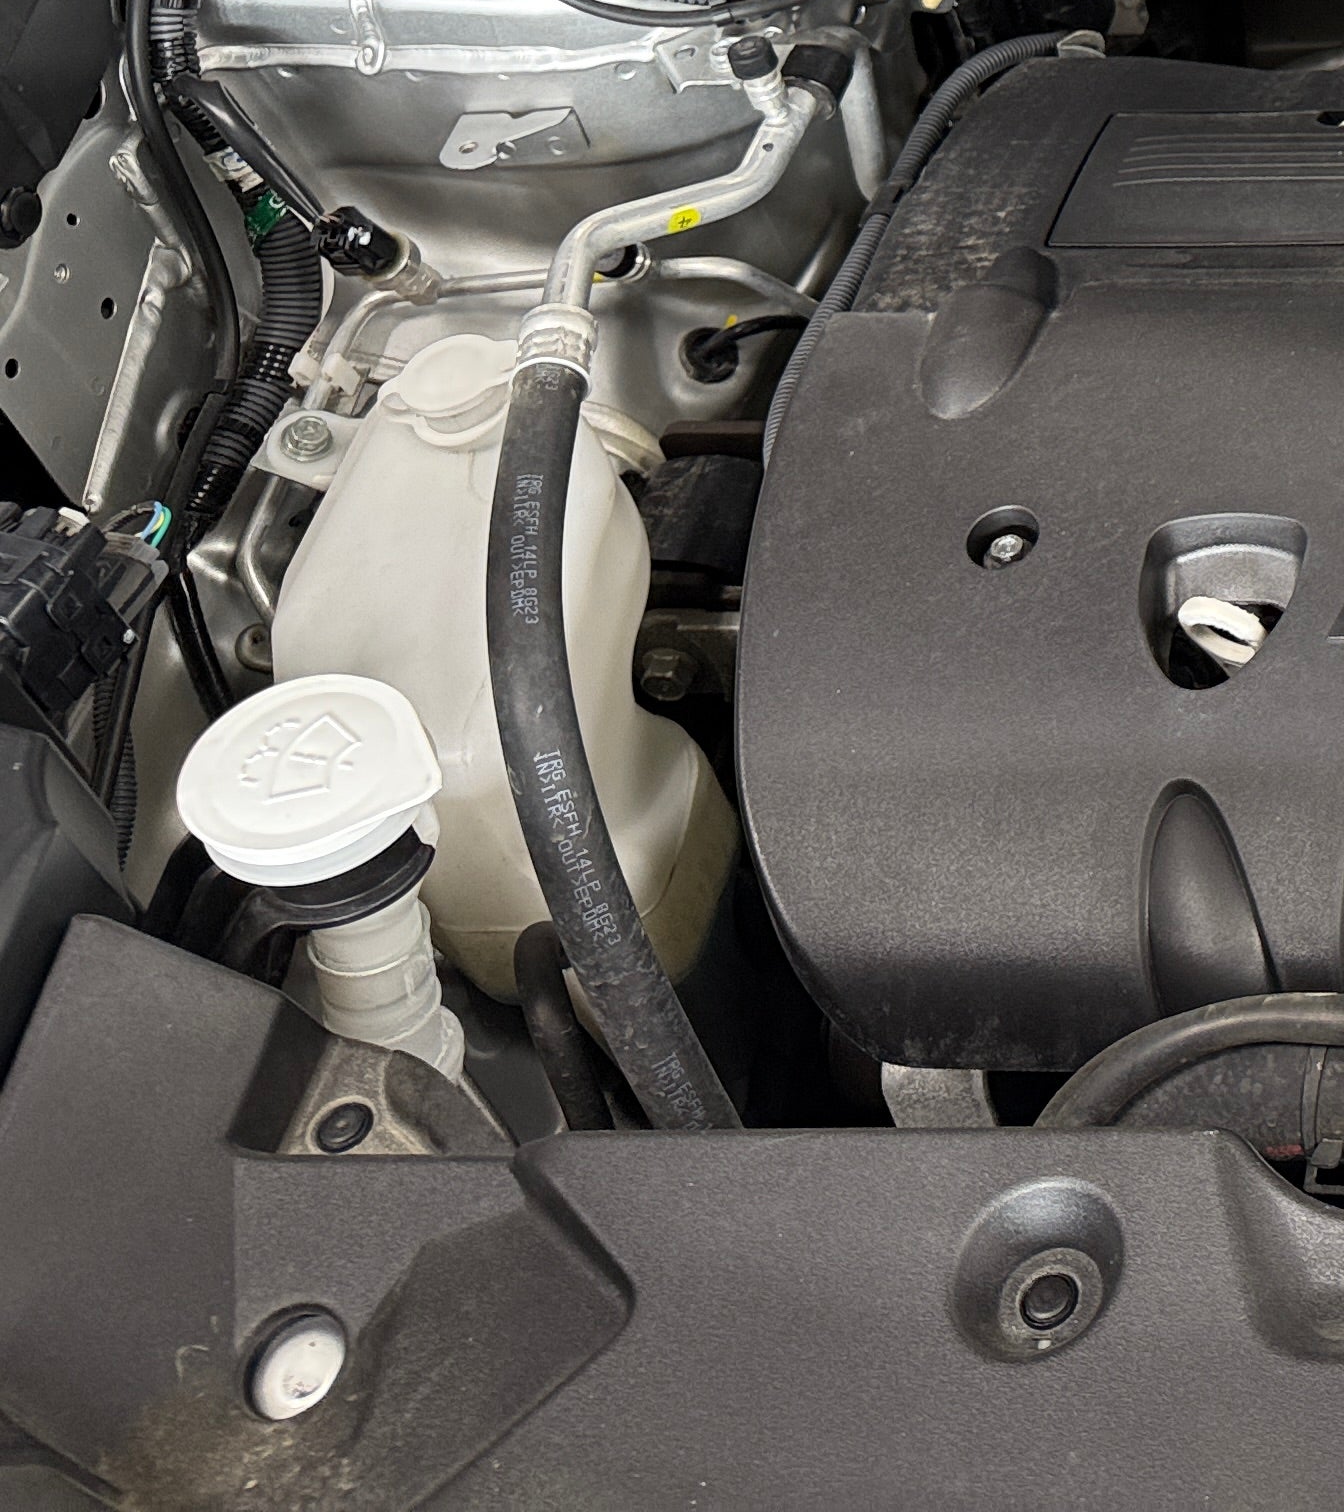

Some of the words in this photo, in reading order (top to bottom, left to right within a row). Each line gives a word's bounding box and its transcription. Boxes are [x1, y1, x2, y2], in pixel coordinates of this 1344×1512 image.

[524, 501, 541, 536] ESFH
[523, 544, 538, 579] 14LP
[523, 587, 540, 625] 8G23
[550, 748, 567, 781] TRG
[557, 788, 582, 840] ESFH
[575, 847, 601, 892] 14LP
[594, 901, 622, 946] 8G23
